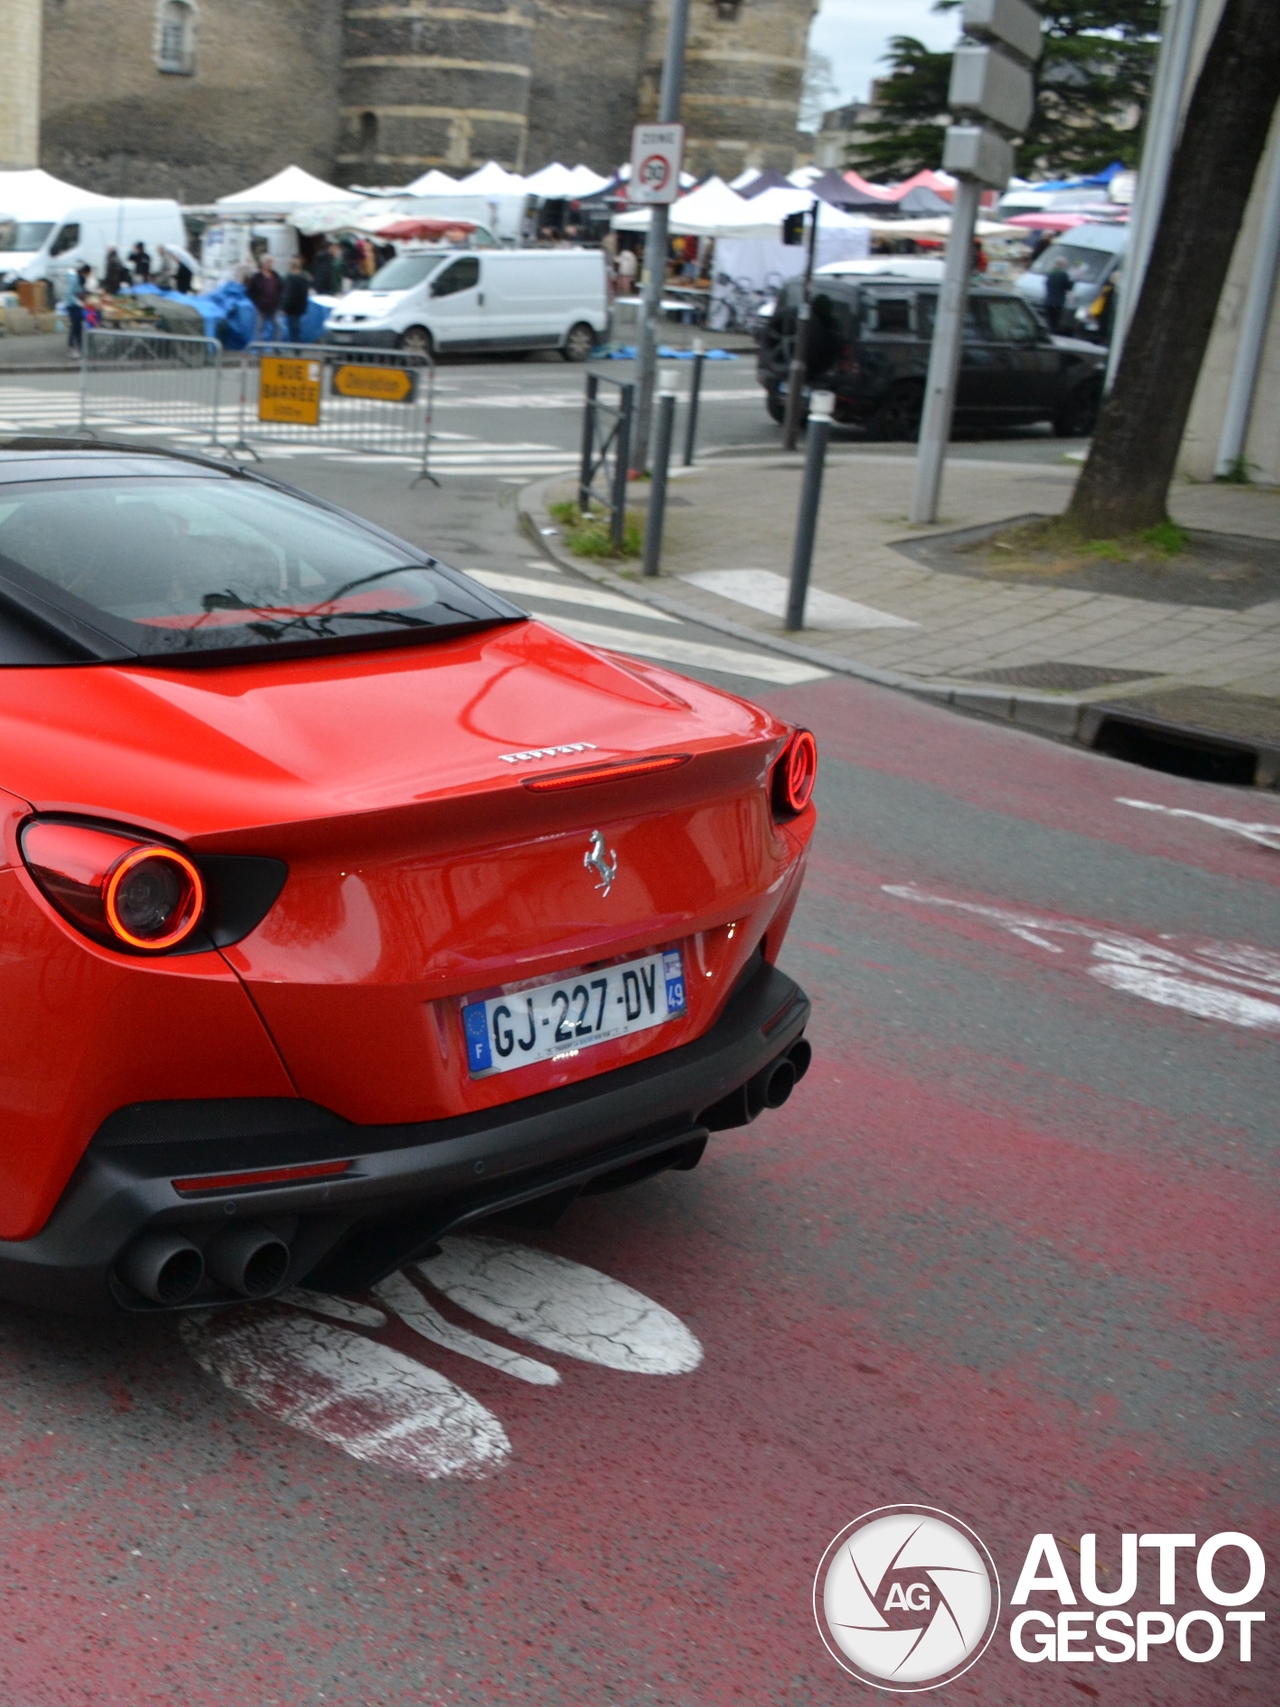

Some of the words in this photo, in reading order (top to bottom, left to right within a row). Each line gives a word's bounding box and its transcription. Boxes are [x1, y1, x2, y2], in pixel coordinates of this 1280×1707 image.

[641, 132, 675, 145] ZONE
[646, 164, 665, 181] 30
[277, 363, 303, 381] RUE
[668, 983, 684, 1007] 49
[493, 964, 656, 1057] GJ-227-DV
[475, 1043, 483, 1059] F
